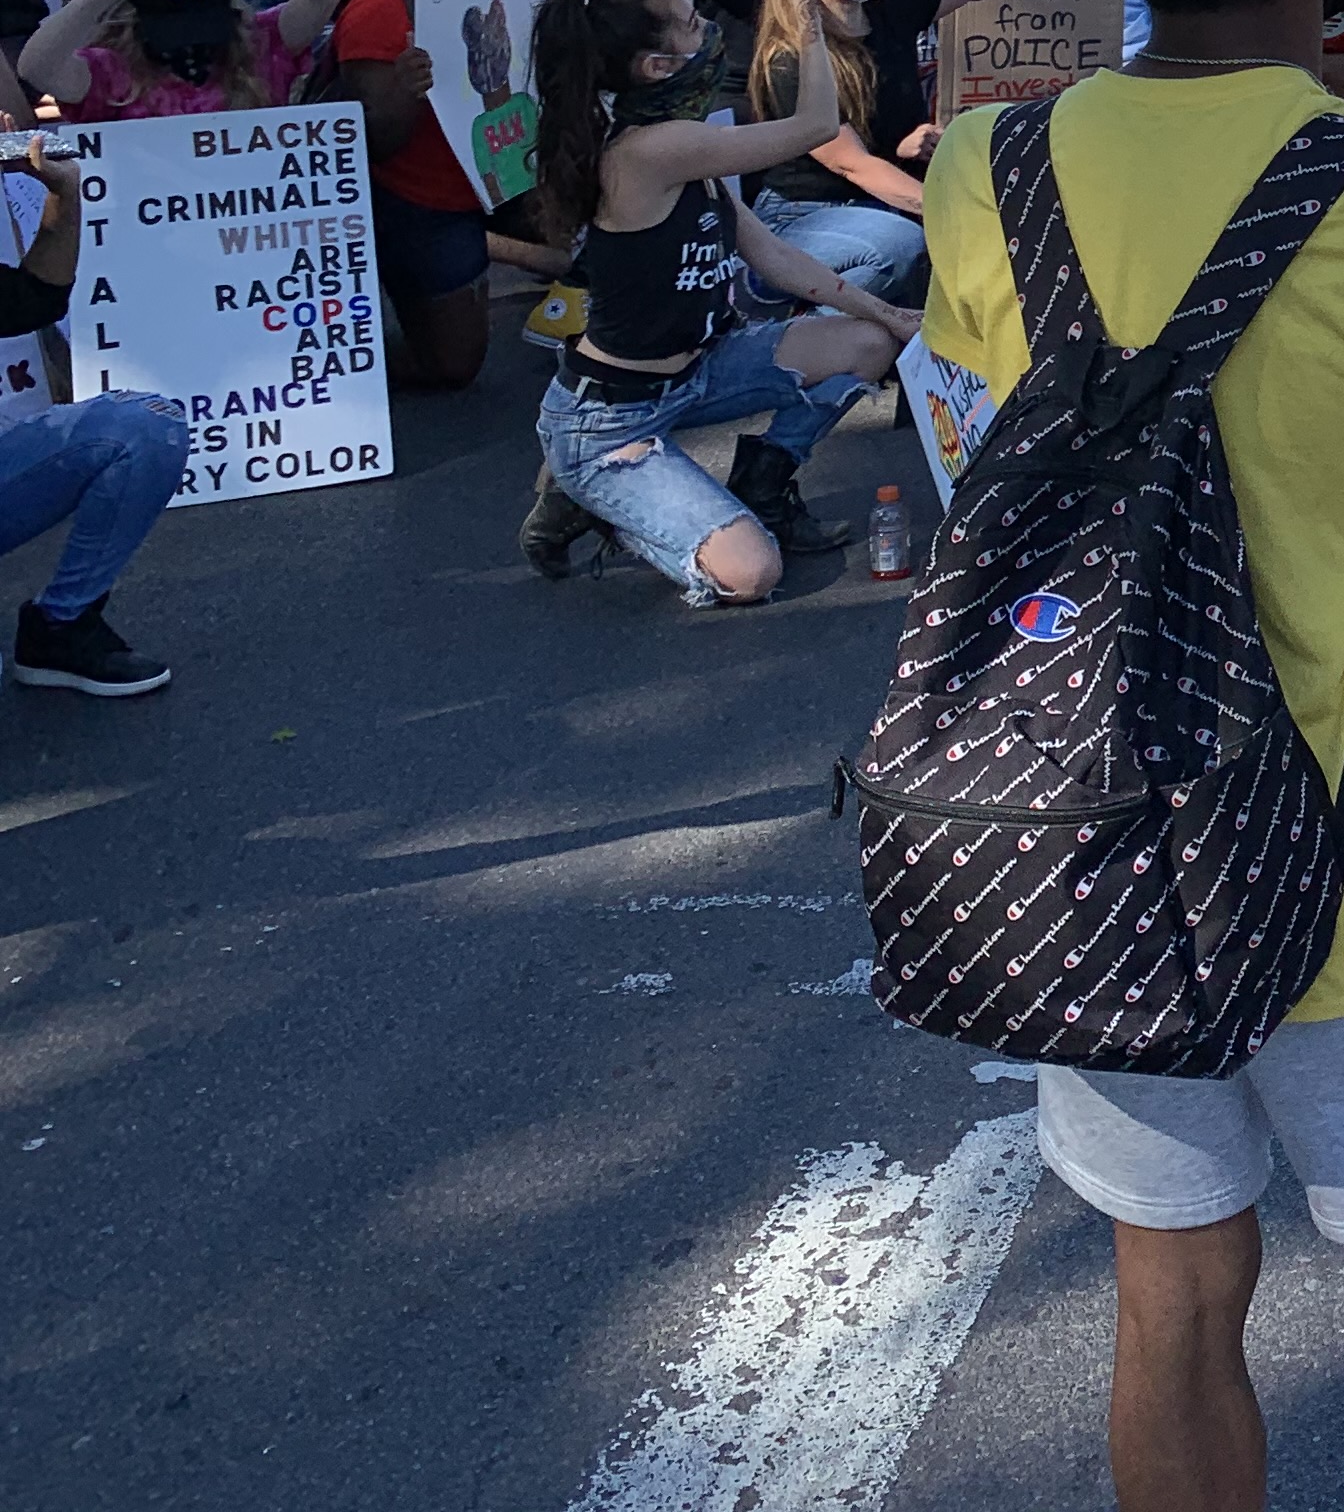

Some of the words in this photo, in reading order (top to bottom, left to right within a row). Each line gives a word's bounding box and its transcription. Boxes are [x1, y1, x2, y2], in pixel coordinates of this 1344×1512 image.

[995, 4, 1076, 32] from
[964, 35, 1110, 73] POLICE
[960, 73, 1077, 99] Invest
[193, 118, 358, 158] BLACKS
[279, 148, 356, 179] ARE
[138, 178, 360, 226] CRIMINALS
[218, 214, 367, 256] WHITES
[290, 241, 368, 275] ARE
[215, 269, 368, 312] RACIST
[263, 294, 373, 332] COPS
[296, 319, 374, 353] ARE
[291, 347, 375, 385] BAD
[246, 419, 282, 449] IN
[246, 443, 381, 483] COLOR
[898, 631, 981, 678] Champion
[1182, 771, 1235, 863] Champion
[1006, 850, 1075, 921] Champion
[1006, 908, 1074, 977] Champion
